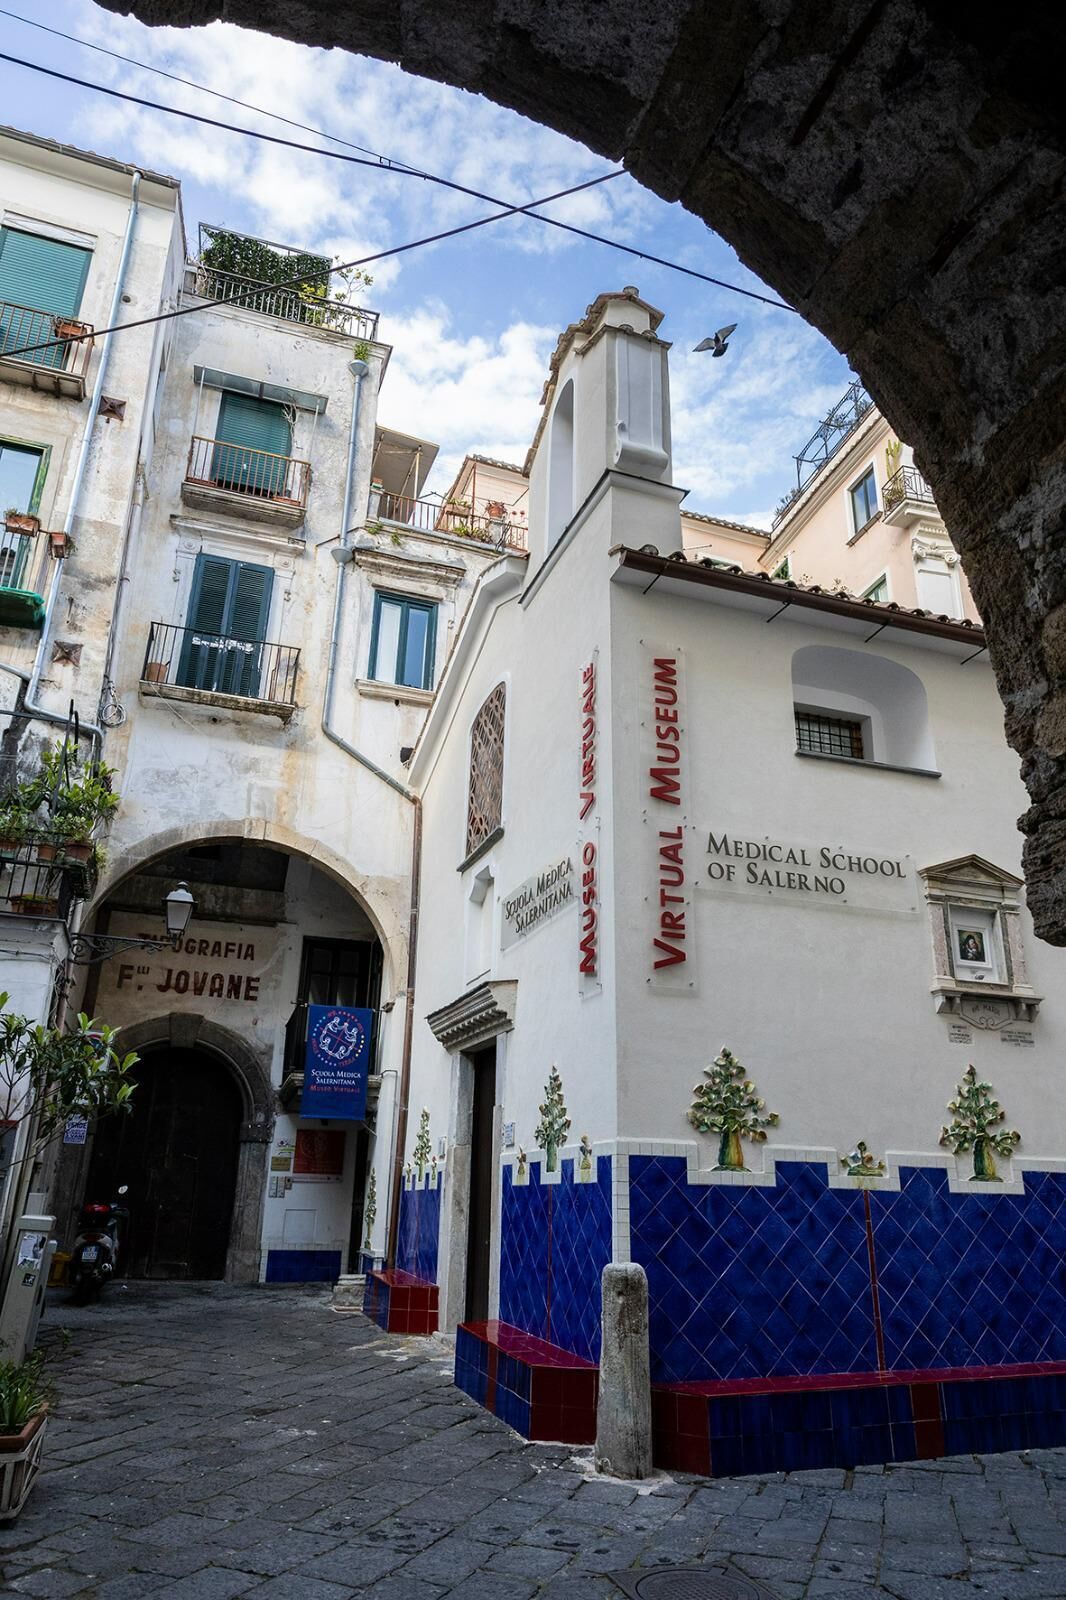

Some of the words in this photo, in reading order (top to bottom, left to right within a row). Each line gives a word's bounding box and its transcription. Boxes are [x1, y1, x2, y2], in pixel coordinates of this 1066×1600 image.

[579, 662, 595, 820] VIRTUALE
[649, 658, 681, 806] MUSEUM
[706, 832, 811, 867] MEDICAL
[819, 847, 907, 879] SCHOOL
[707, 861, 736, 882] OF
[746, 862, 846, 896] SALERNO
[505, 887, 534, 920] SCUOLA
[536, 857, 573, 897] MEDICA
[515, 881, 572, 934] SALERNITANA
[579, 842, 595, 973] MUSEO
[653, 826, 687, 970] VIRTUAL
[156, 968, 260, 1001] JOVANE
[311, 1069, 335, 1077] SCUOLA
